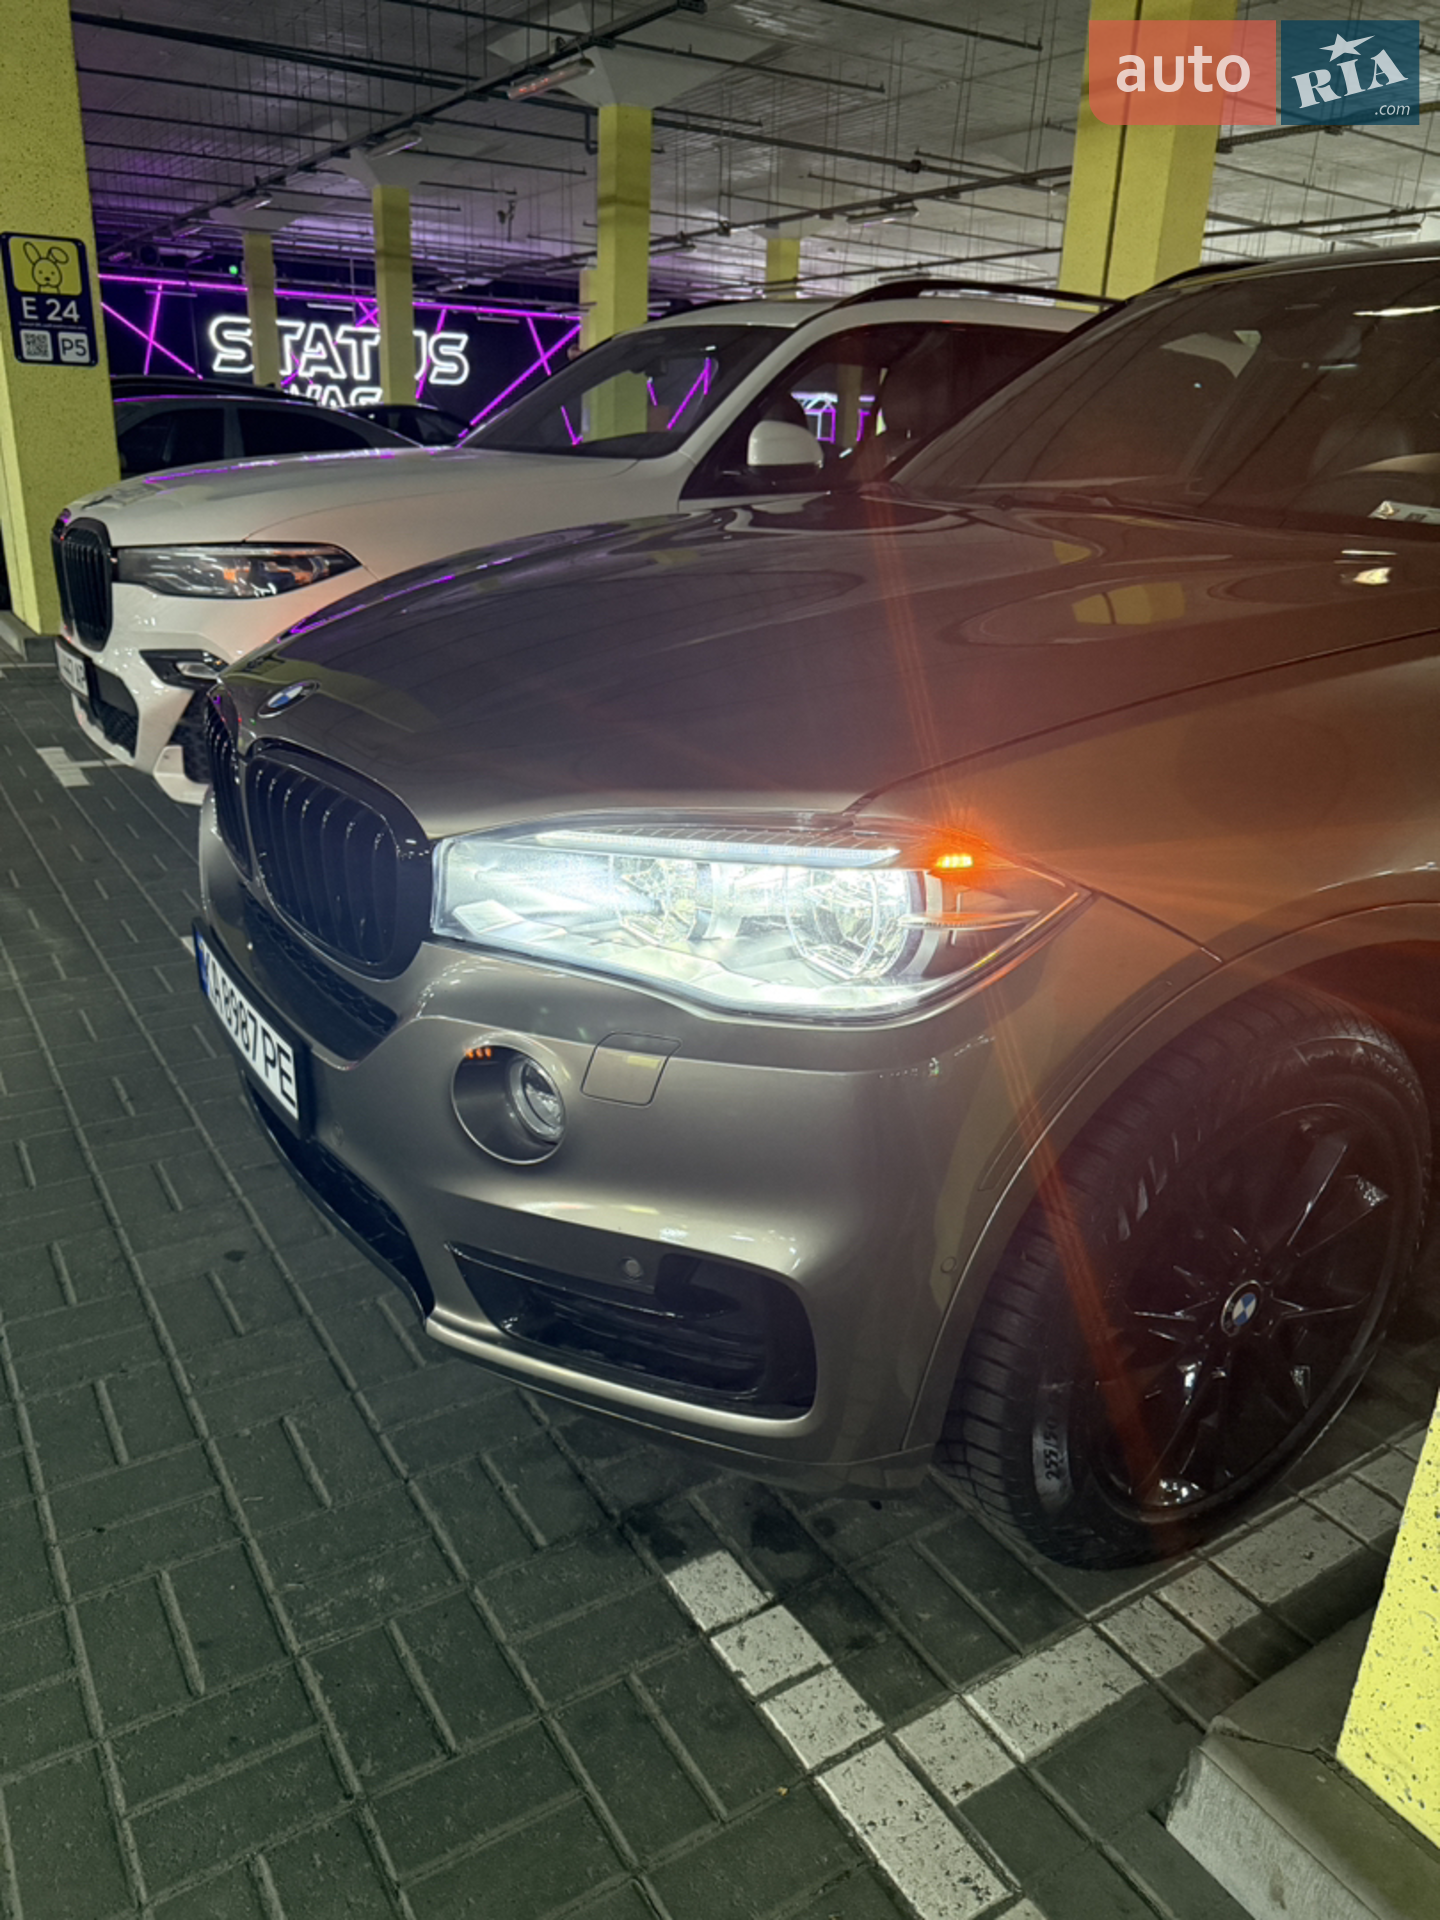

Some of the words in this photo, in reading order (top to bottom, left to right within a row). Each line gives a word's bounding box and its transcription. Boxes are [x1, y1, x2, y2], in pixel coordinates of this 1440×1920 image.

[21, 296, 39, 320] E
[45, 298, 80, 323] 24
[61, 337, 87, 358] P5
